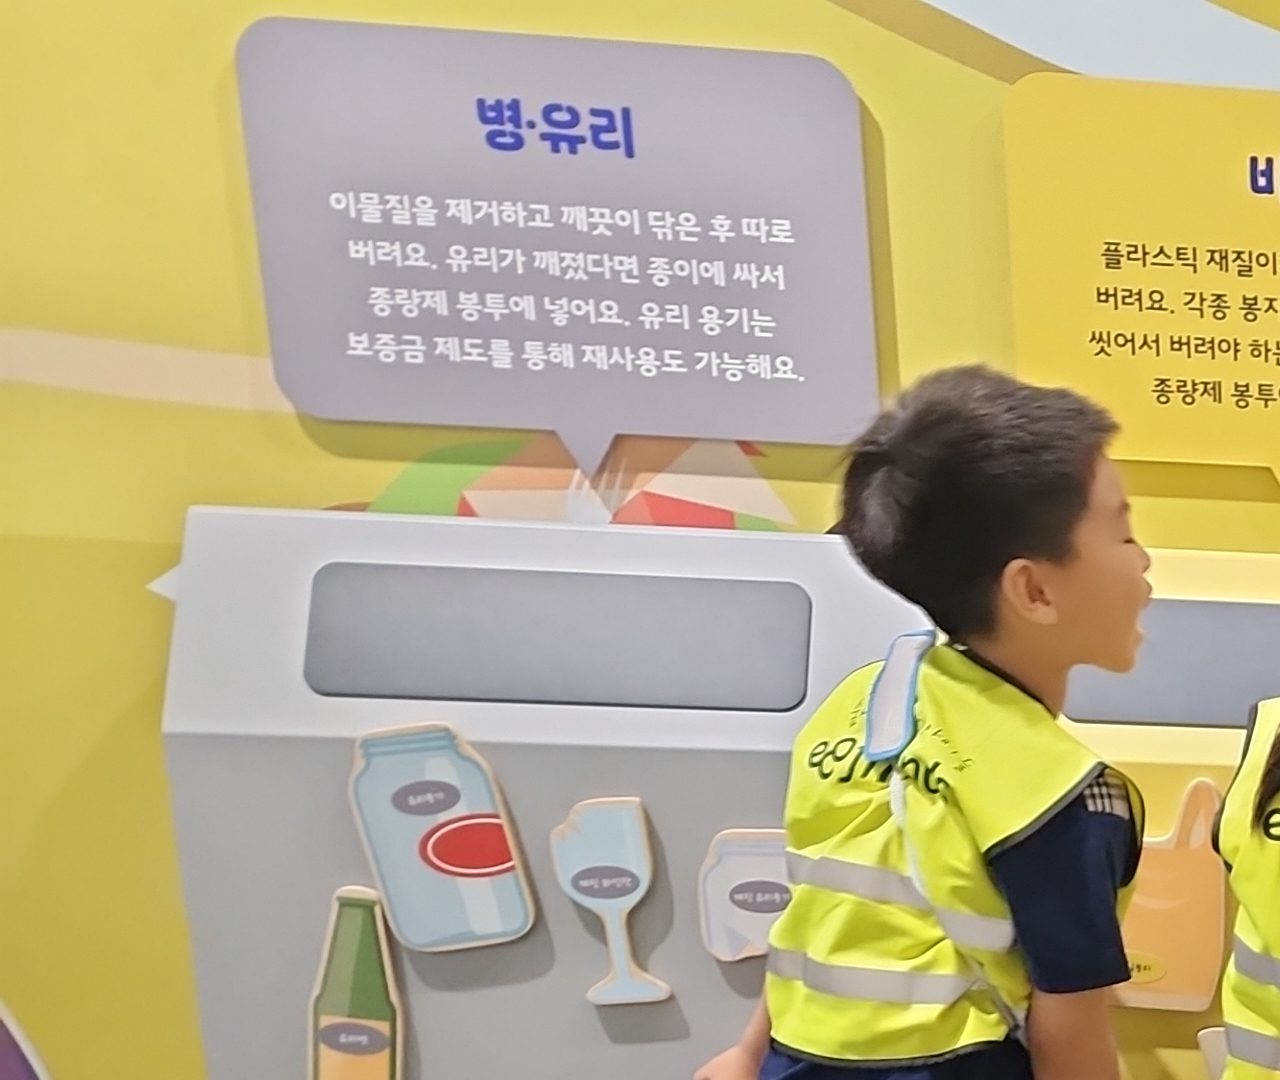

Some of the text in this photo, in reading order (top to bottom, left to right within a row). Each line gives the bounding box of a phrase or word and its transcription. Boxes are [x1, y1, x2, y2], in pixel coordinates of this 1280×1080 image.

[476, 97, 636, 160] 병·유리
[329, 191, 795, 244] 이물질을 제거하고 깨끗이 닦은 후 따로
[347, 239, 786, 291] 버려요. 유리가 깨졌다면 종이에 싸서
[1100, 241, 1198, 275] 플라스틱
[367, 286, 777, 338] 종량제 봉투에 넣어요. 유리 용기는
[1096, 286, 1175, 315] 버려요.
[1183, 291, 1231, 321] 각종
[346, 332, 805, 382] 보증금 제도를 통해 재사용도 가능해요.
[1089, 330, 1161, 358] 씻어서
[1169, 335, 1241, 362] 버려야
[1151, 377, 1223, 406] 종량제
